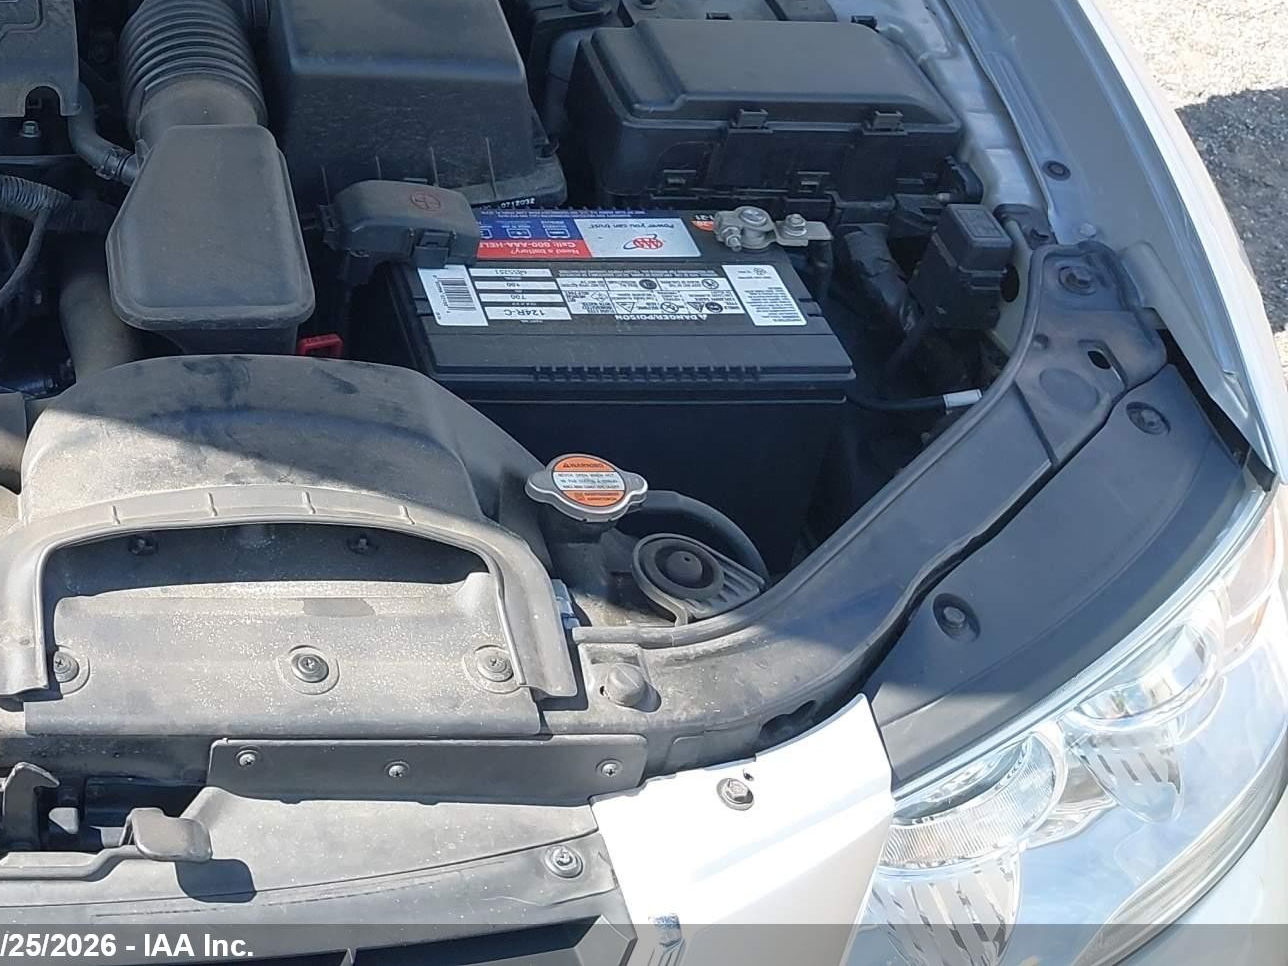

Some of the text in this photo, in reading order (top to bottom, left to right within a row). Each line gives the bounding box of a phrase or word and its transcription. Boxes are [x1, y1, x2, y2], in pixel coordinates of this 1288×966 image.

[589, 222, 610, 230] trust
[629, 222, 646, 230] you
[647, 222, 675, 230] Power
[552, 241, 577, 249] Call:
[631, 237, 663, 250] AAA
[510, 247, 547, 255] battery?
[503, 309, 545, 317] 124R-C
[614, 314, 698, 322] DANGER/POISON
